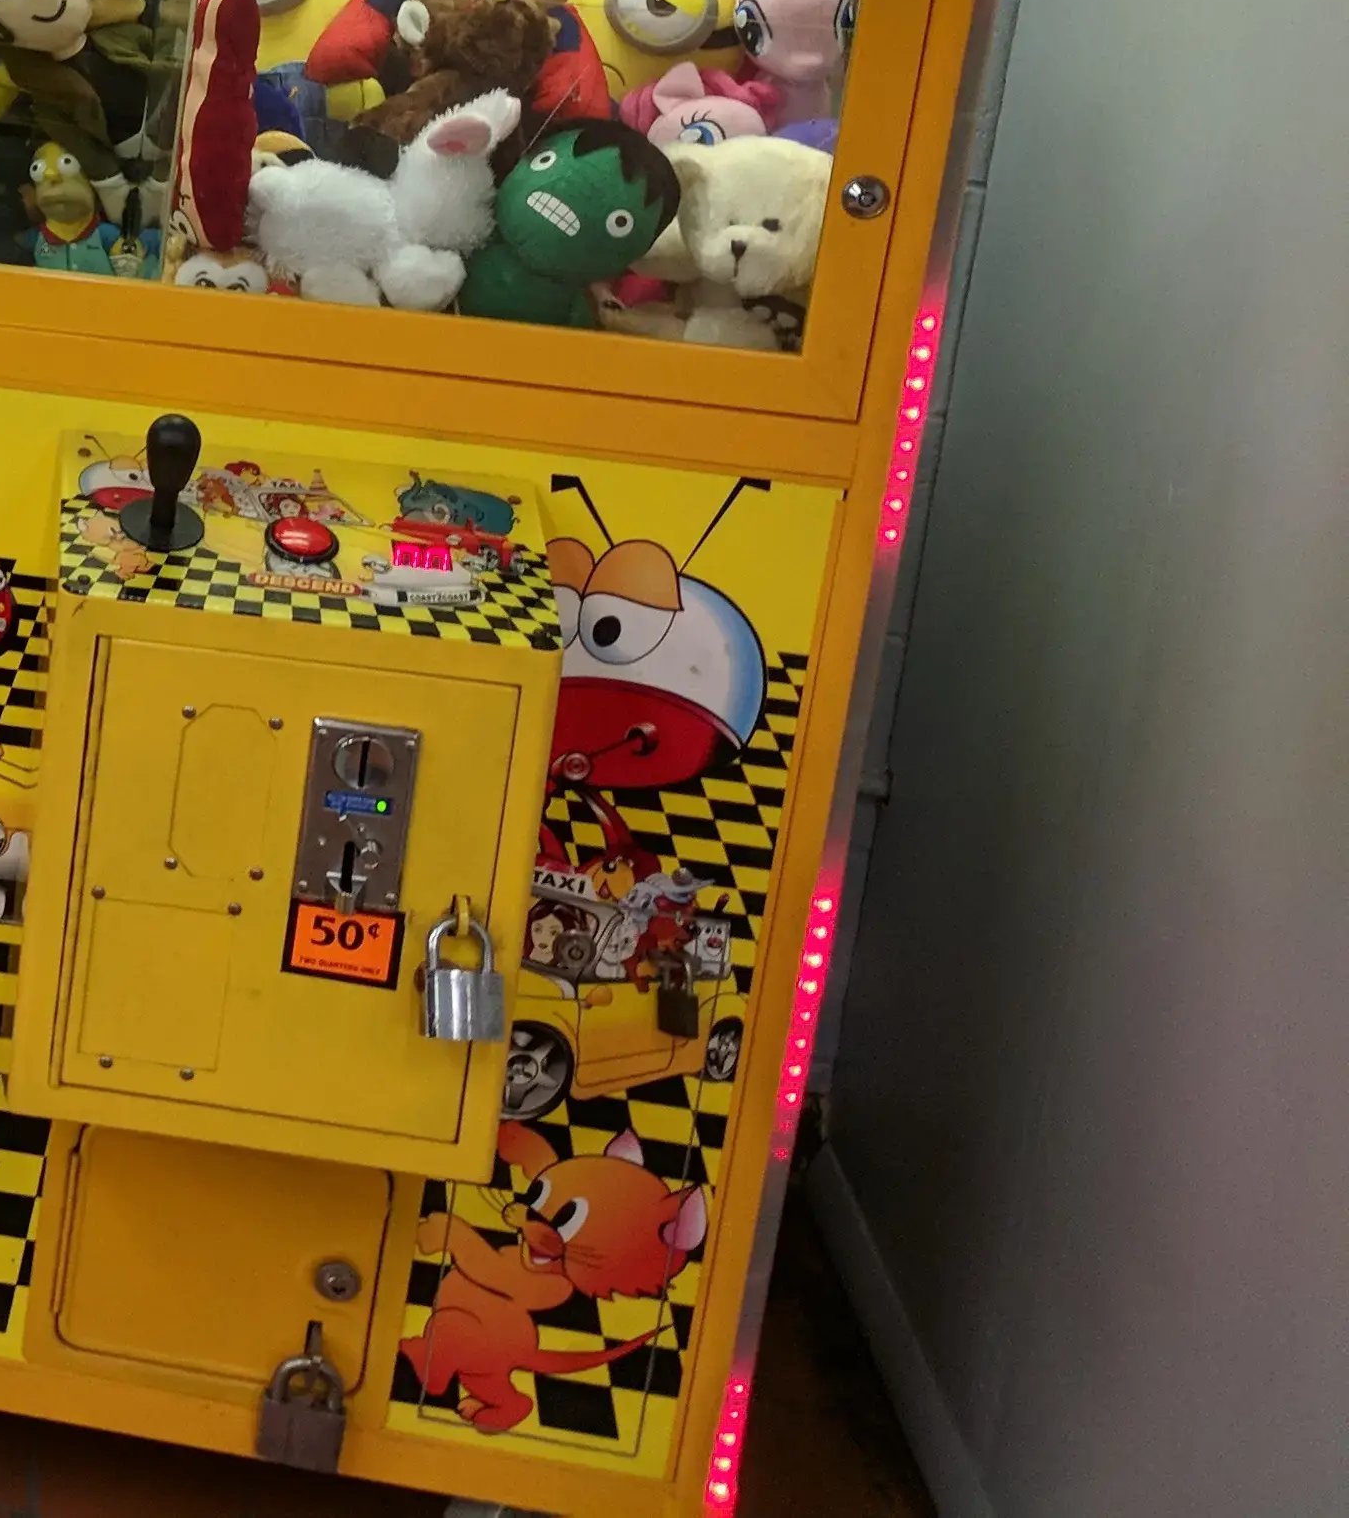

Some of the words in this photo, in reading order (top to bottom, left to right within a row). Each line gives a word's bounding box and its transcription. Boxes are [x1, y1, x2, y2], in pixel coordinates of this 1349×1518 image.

[254, 572, 357, 595] DESCEND
[533, 869, 586, 895] TAXI
[311, 914, 381, 951] 50¢
